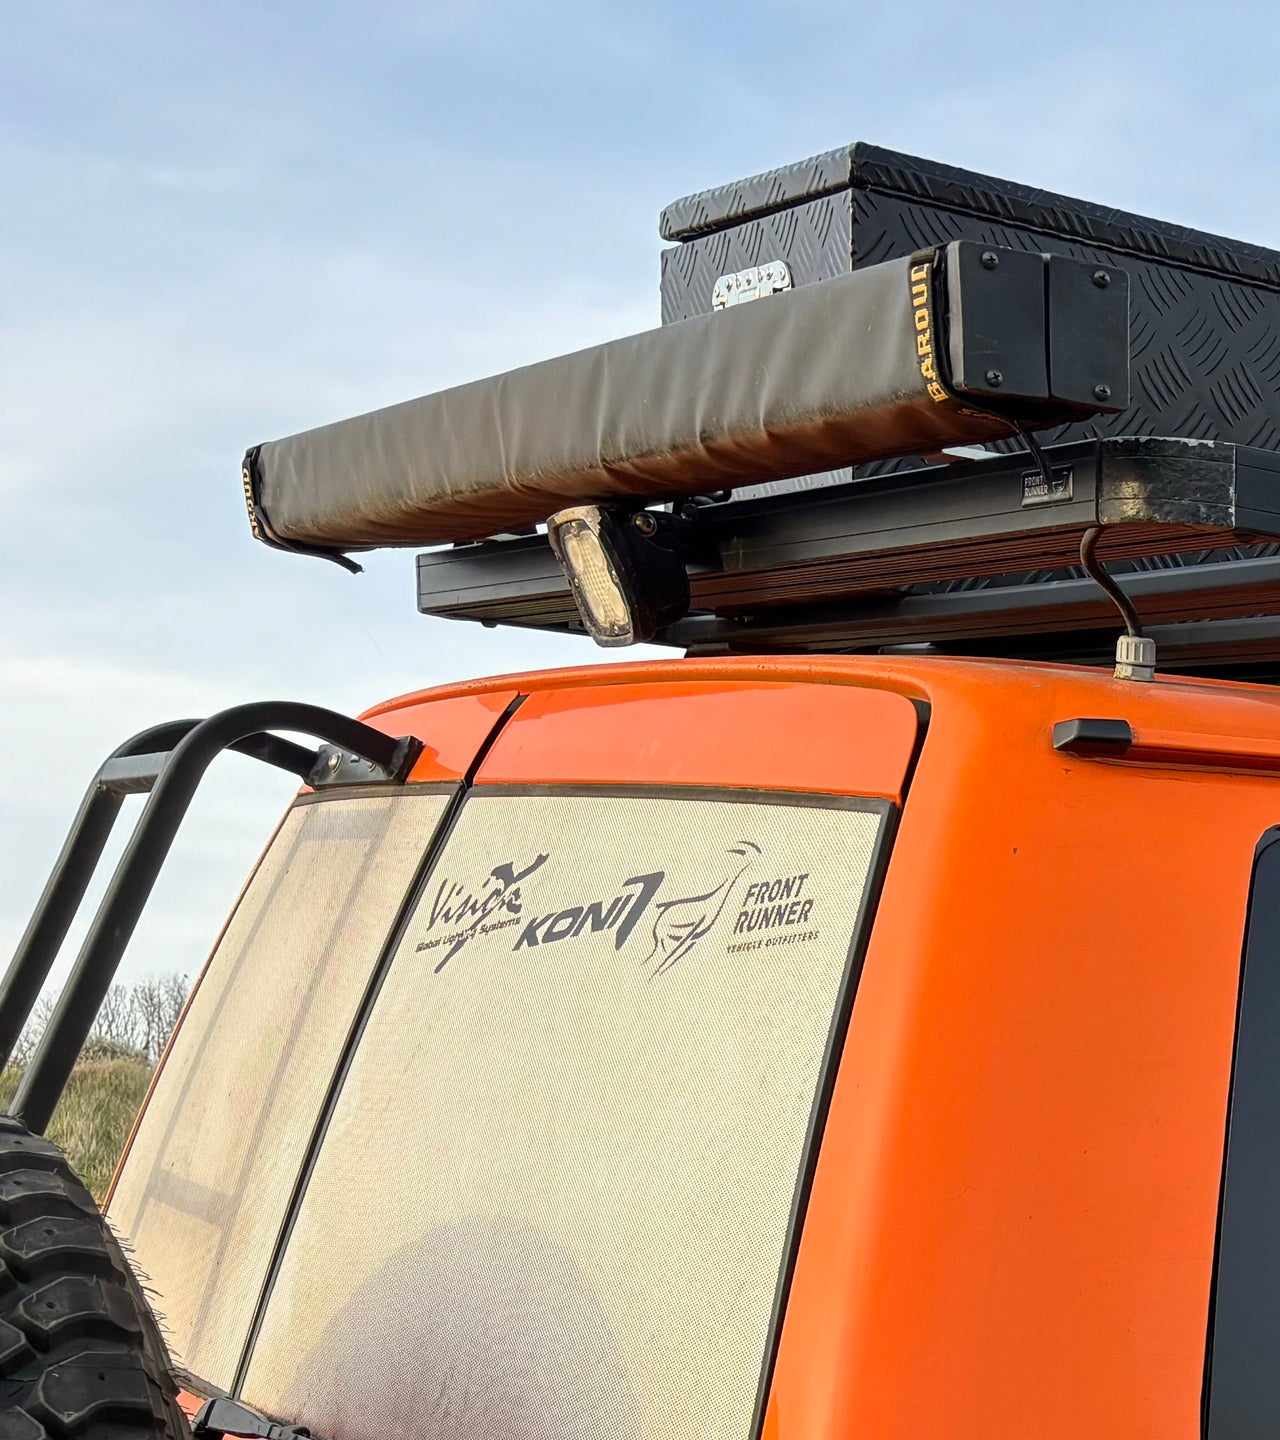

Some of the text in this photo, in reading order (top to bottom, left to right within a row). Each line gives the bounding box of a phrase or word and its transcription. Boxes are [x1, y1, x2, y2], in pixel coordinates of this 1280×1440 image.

[743, 873, 809, 907] FRONT
[733, 899, 814, 935] RUNNER
[765, 931, 819, 947] OUTFITTERS
